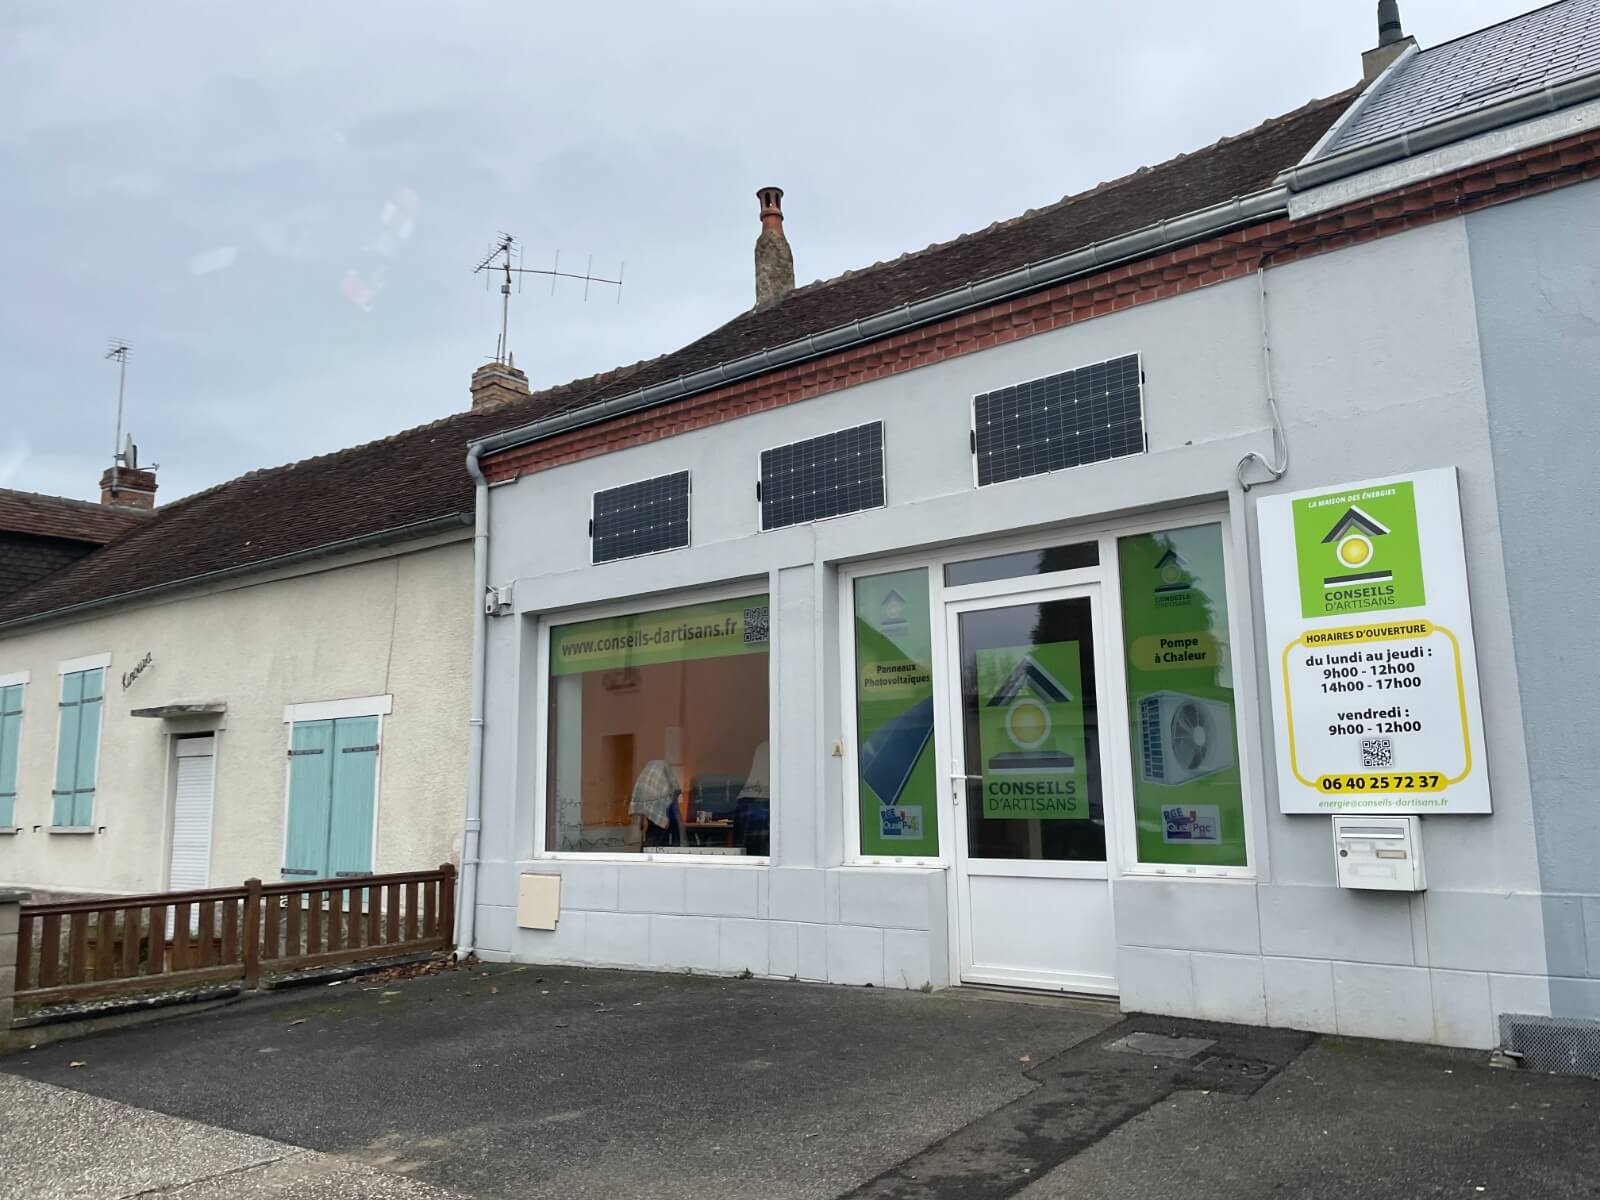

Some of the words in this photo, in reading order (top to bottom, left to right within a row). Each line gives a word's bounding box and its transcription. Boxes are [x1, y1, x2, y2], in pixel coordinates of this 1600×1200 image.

[1308, 501, 1318, 509] LA
[1318, 496, 1346, 507] MAISON
[1347, 494, 1361, 503] DES
[1362, 488, 1397, 501] ÉNERGIES
[1324, 585, 1395, 601] CONSEILS
[1325, 596, 1395, 612] D'ARTISANS
[561, 618, 738, 657] www.conseils-dartisans.fr
[1306, 631, 1354, 644] HORAIRES
[1356, 624, 1426, 639] D'OUVERTURE
[1160, 637, 1199, 649] Pompe
[1154, 653, 1161, 664] à
[1163, 650, 1206, 662] Chaleur
[1305, 655, 1323, 667] du
[1326, 651, 1362, 665] lundi
[1365, 652, 1383, 662] au
[1385, 646, 1424, 662] jeudi
[876, 663, 916, 674] Panneaux
[1323, 666, 1358, 679] 9h00
[1370, 662, 1415, 676] 12h00
[864, 673, 930, 687] Photovoltaïques
[1321, 680, 1364, 694] 14h00
[1375, 676, 1421, 690] 17h00
[1337, 707, 1401, 721] vendredi
[1329, 724, 1364, 736] 9h00
[1377, 720, 1421, 734] 12h00
[988, 780, 1076, 796] CONSEILS
[1322, 777, 1342, 790] 06
[1345, 777, 1365, 789] 40
[1369, 776, 1389, 789] 25
[1394, 776, 1415, 788] 72
[1419, 775, 1439, 788] 37
[989, 798, 1077, 811] D'ARTISANS
[1318, 798, 1449, 810] energie@conseils-dartisans.fr
